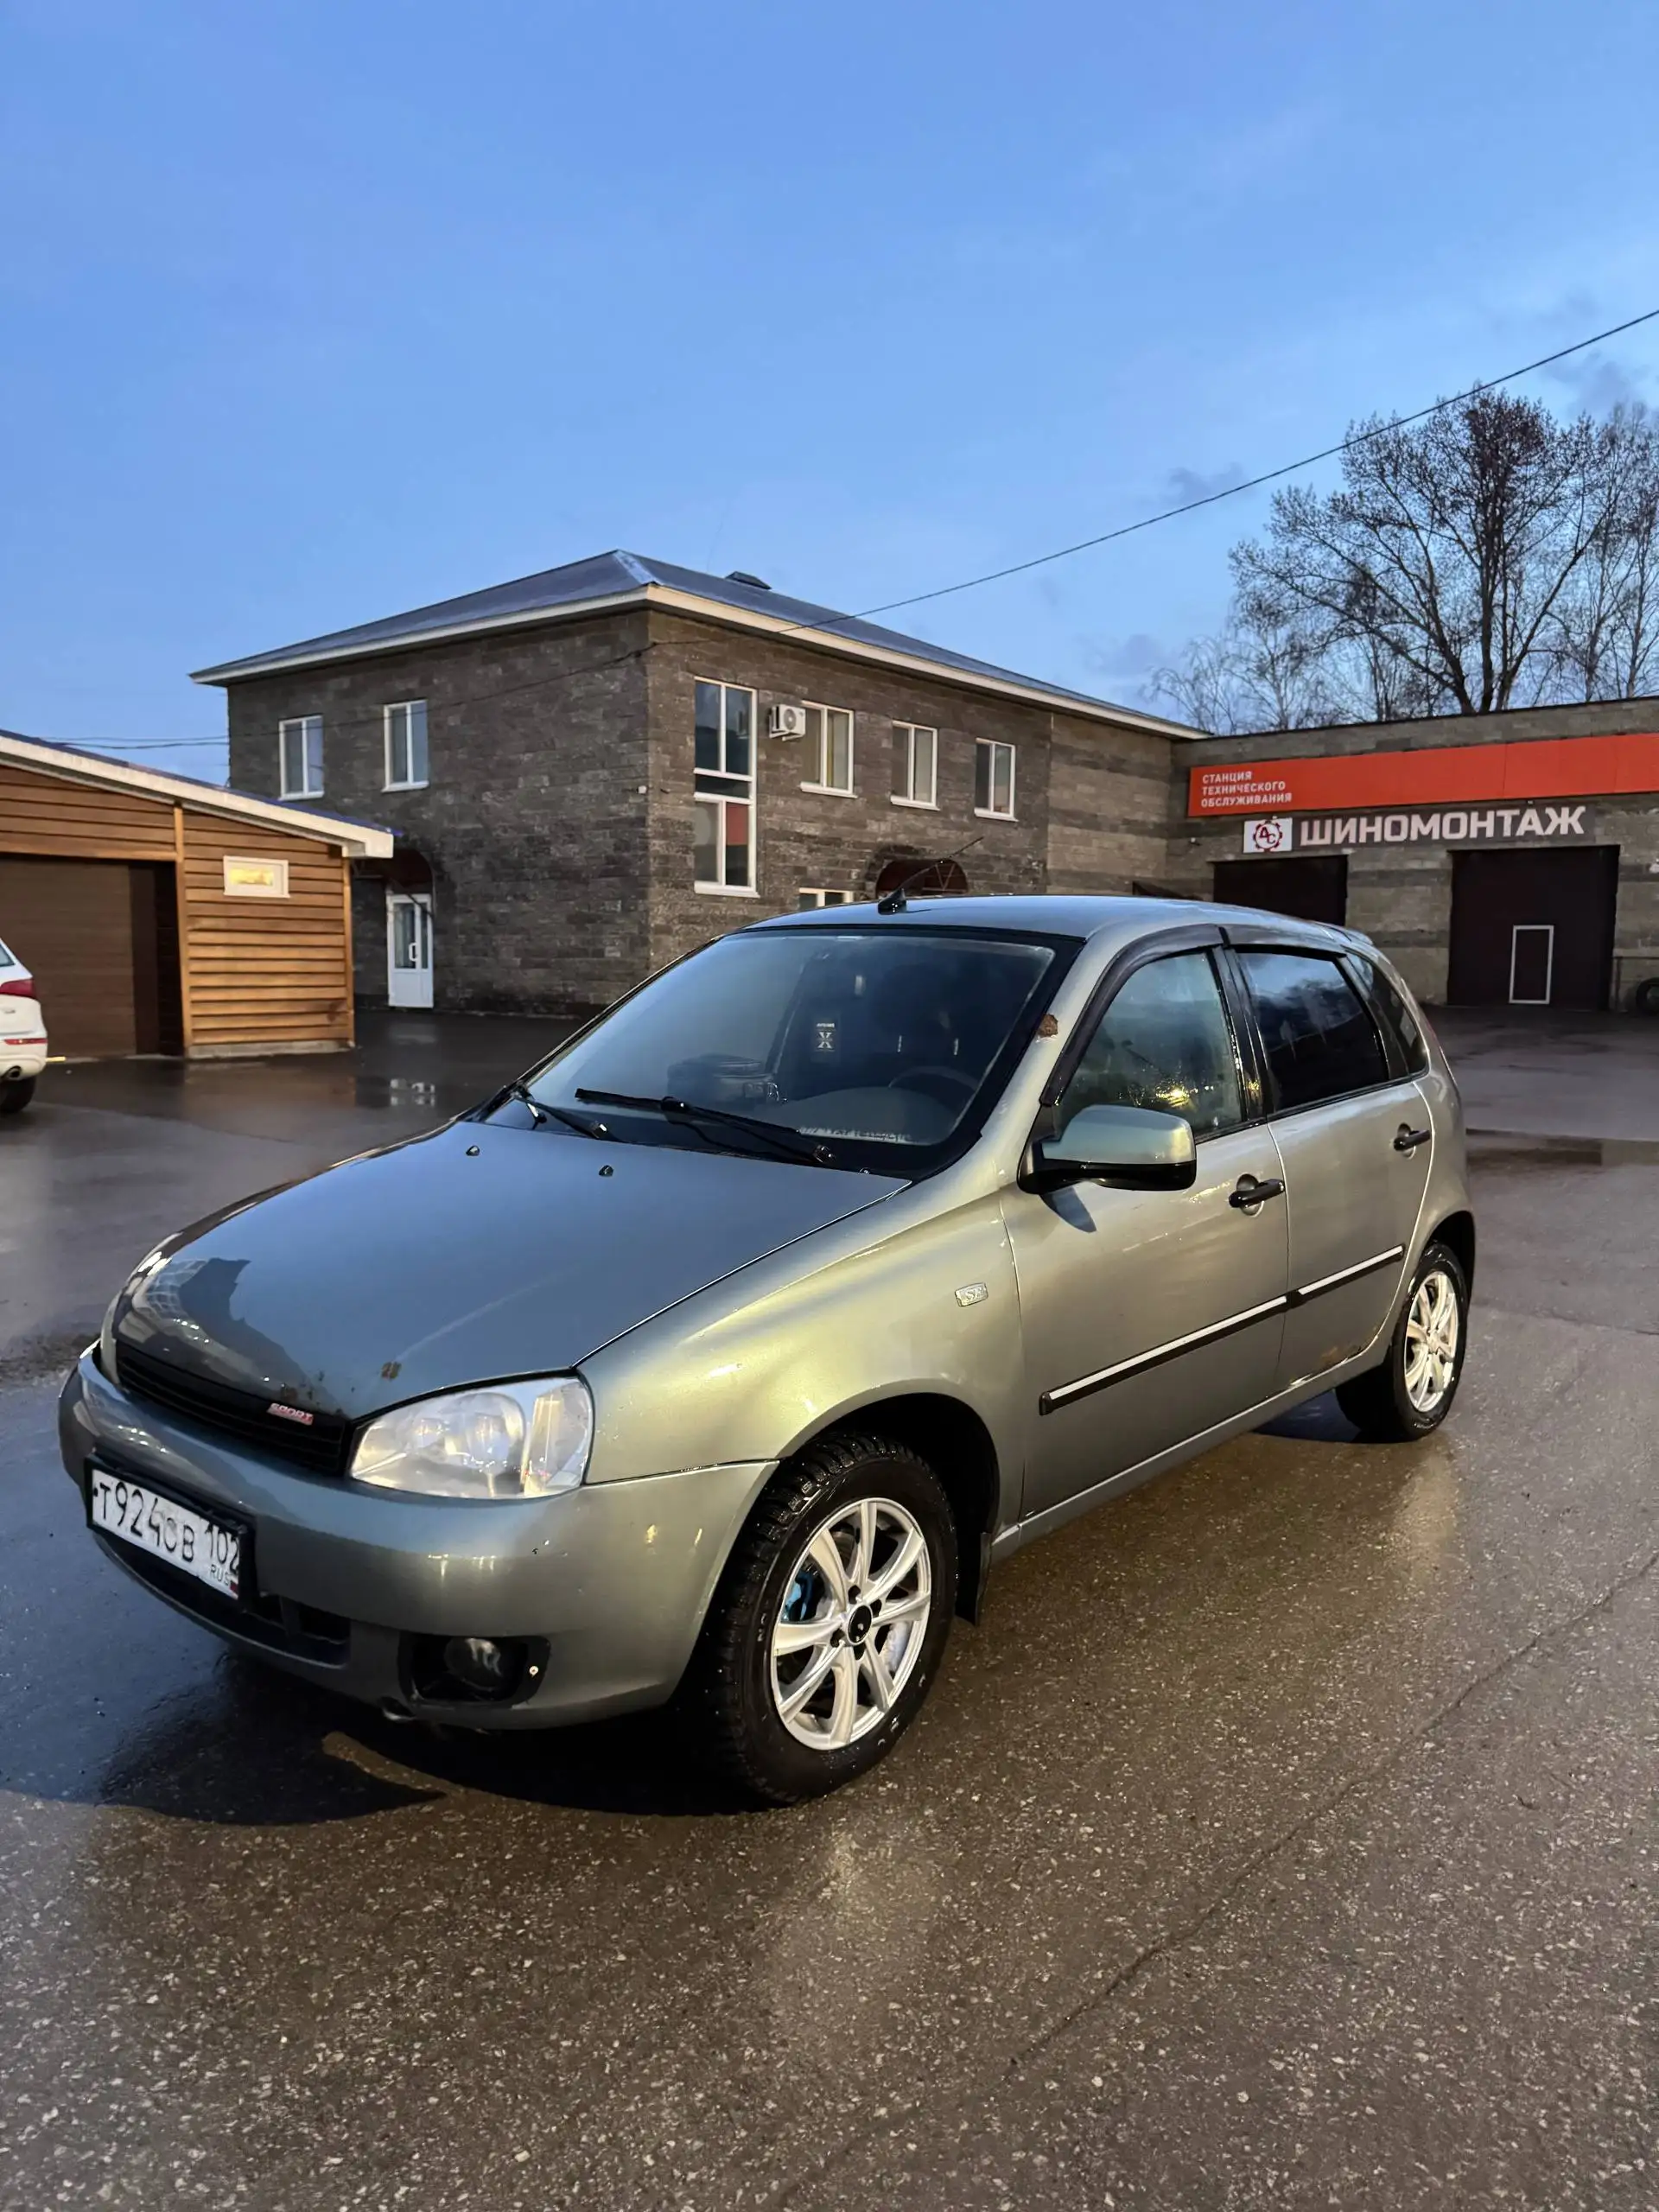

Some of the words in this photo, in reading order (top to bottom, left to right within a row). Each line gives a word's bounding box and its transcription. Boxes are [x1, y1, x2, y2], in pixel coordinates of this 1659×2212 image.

[1202, 771, 1252, 784] СТАНЦИЯ
[1202, 781, 1286, 796] ТЕХНИЧЕСКОГО
[1201, 792, 1292, 808] ОБСЛУЖИВАНИЯ
[1300, 805, 1586, 846] ШИНОМОНТАЖ
[209, 1563, 232, 1587] RUS
